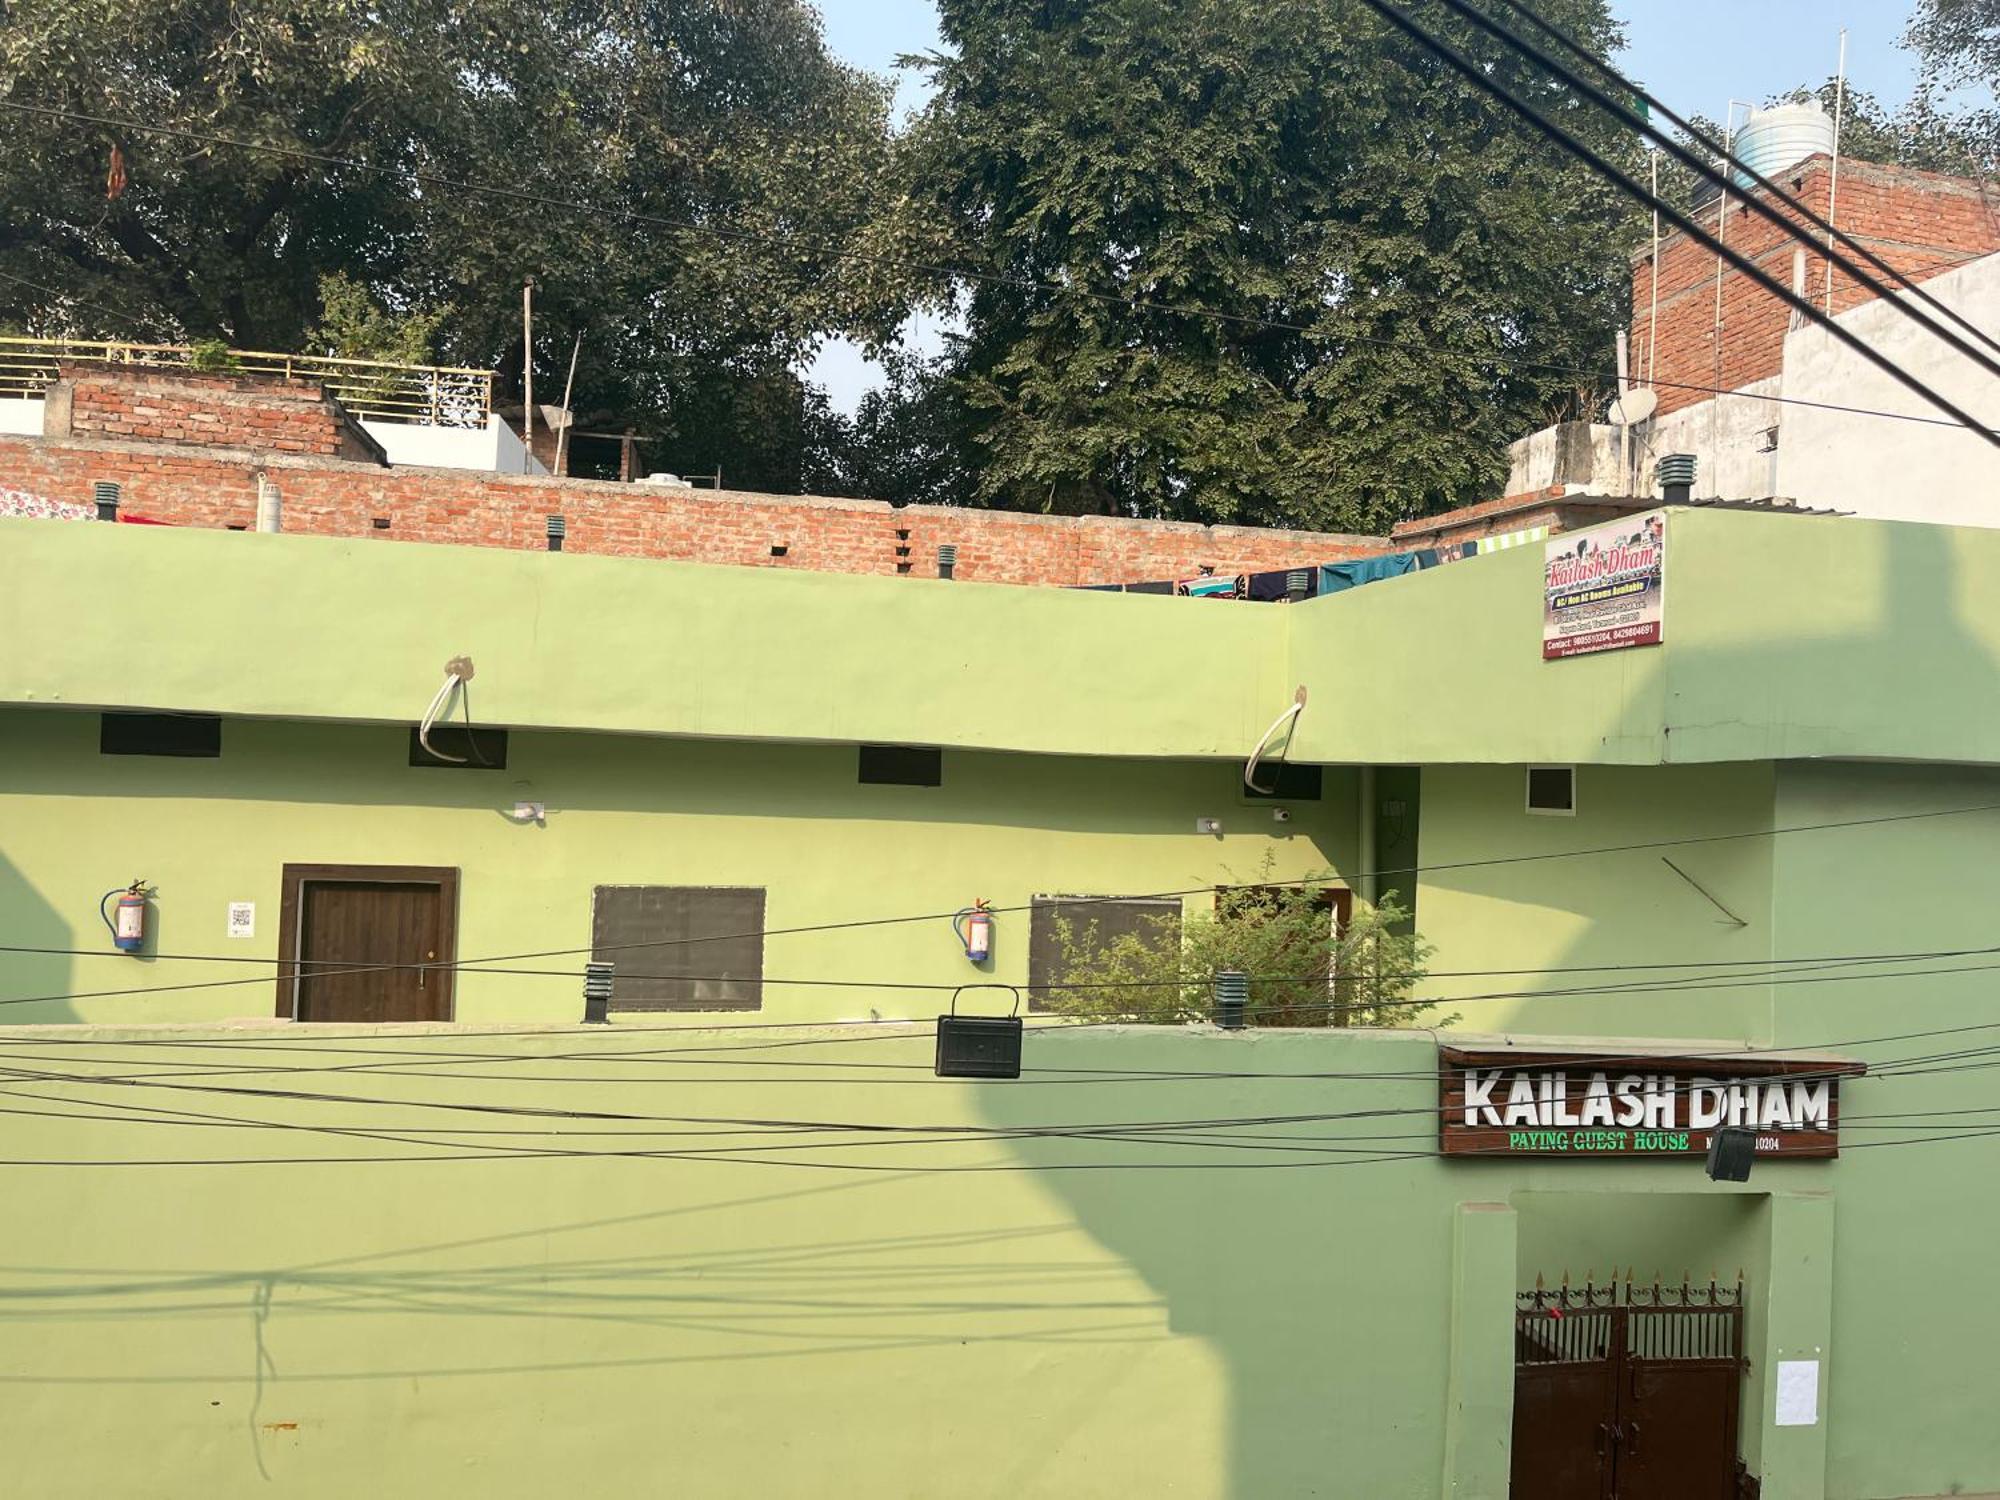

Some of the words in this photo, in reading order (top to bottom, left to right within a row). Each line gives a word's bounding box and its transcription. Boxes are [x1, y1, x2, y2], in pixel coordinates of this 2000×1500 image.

[1550, 552, 1605, 587] Kailash
[1608, 545, 1655, 574] Dham
[1464, 1069, 1675, 1128] KAILASH
[1689, 1076, 1829, 1130] DHAM
[1509, 1131, 1569, 1150] PAYING
[1573, 1131, 1628, 1150] GUEST
[1633, 1131, 1689, 1151] HOUSE
[1755, 1136, 1779, 1151] 10204
